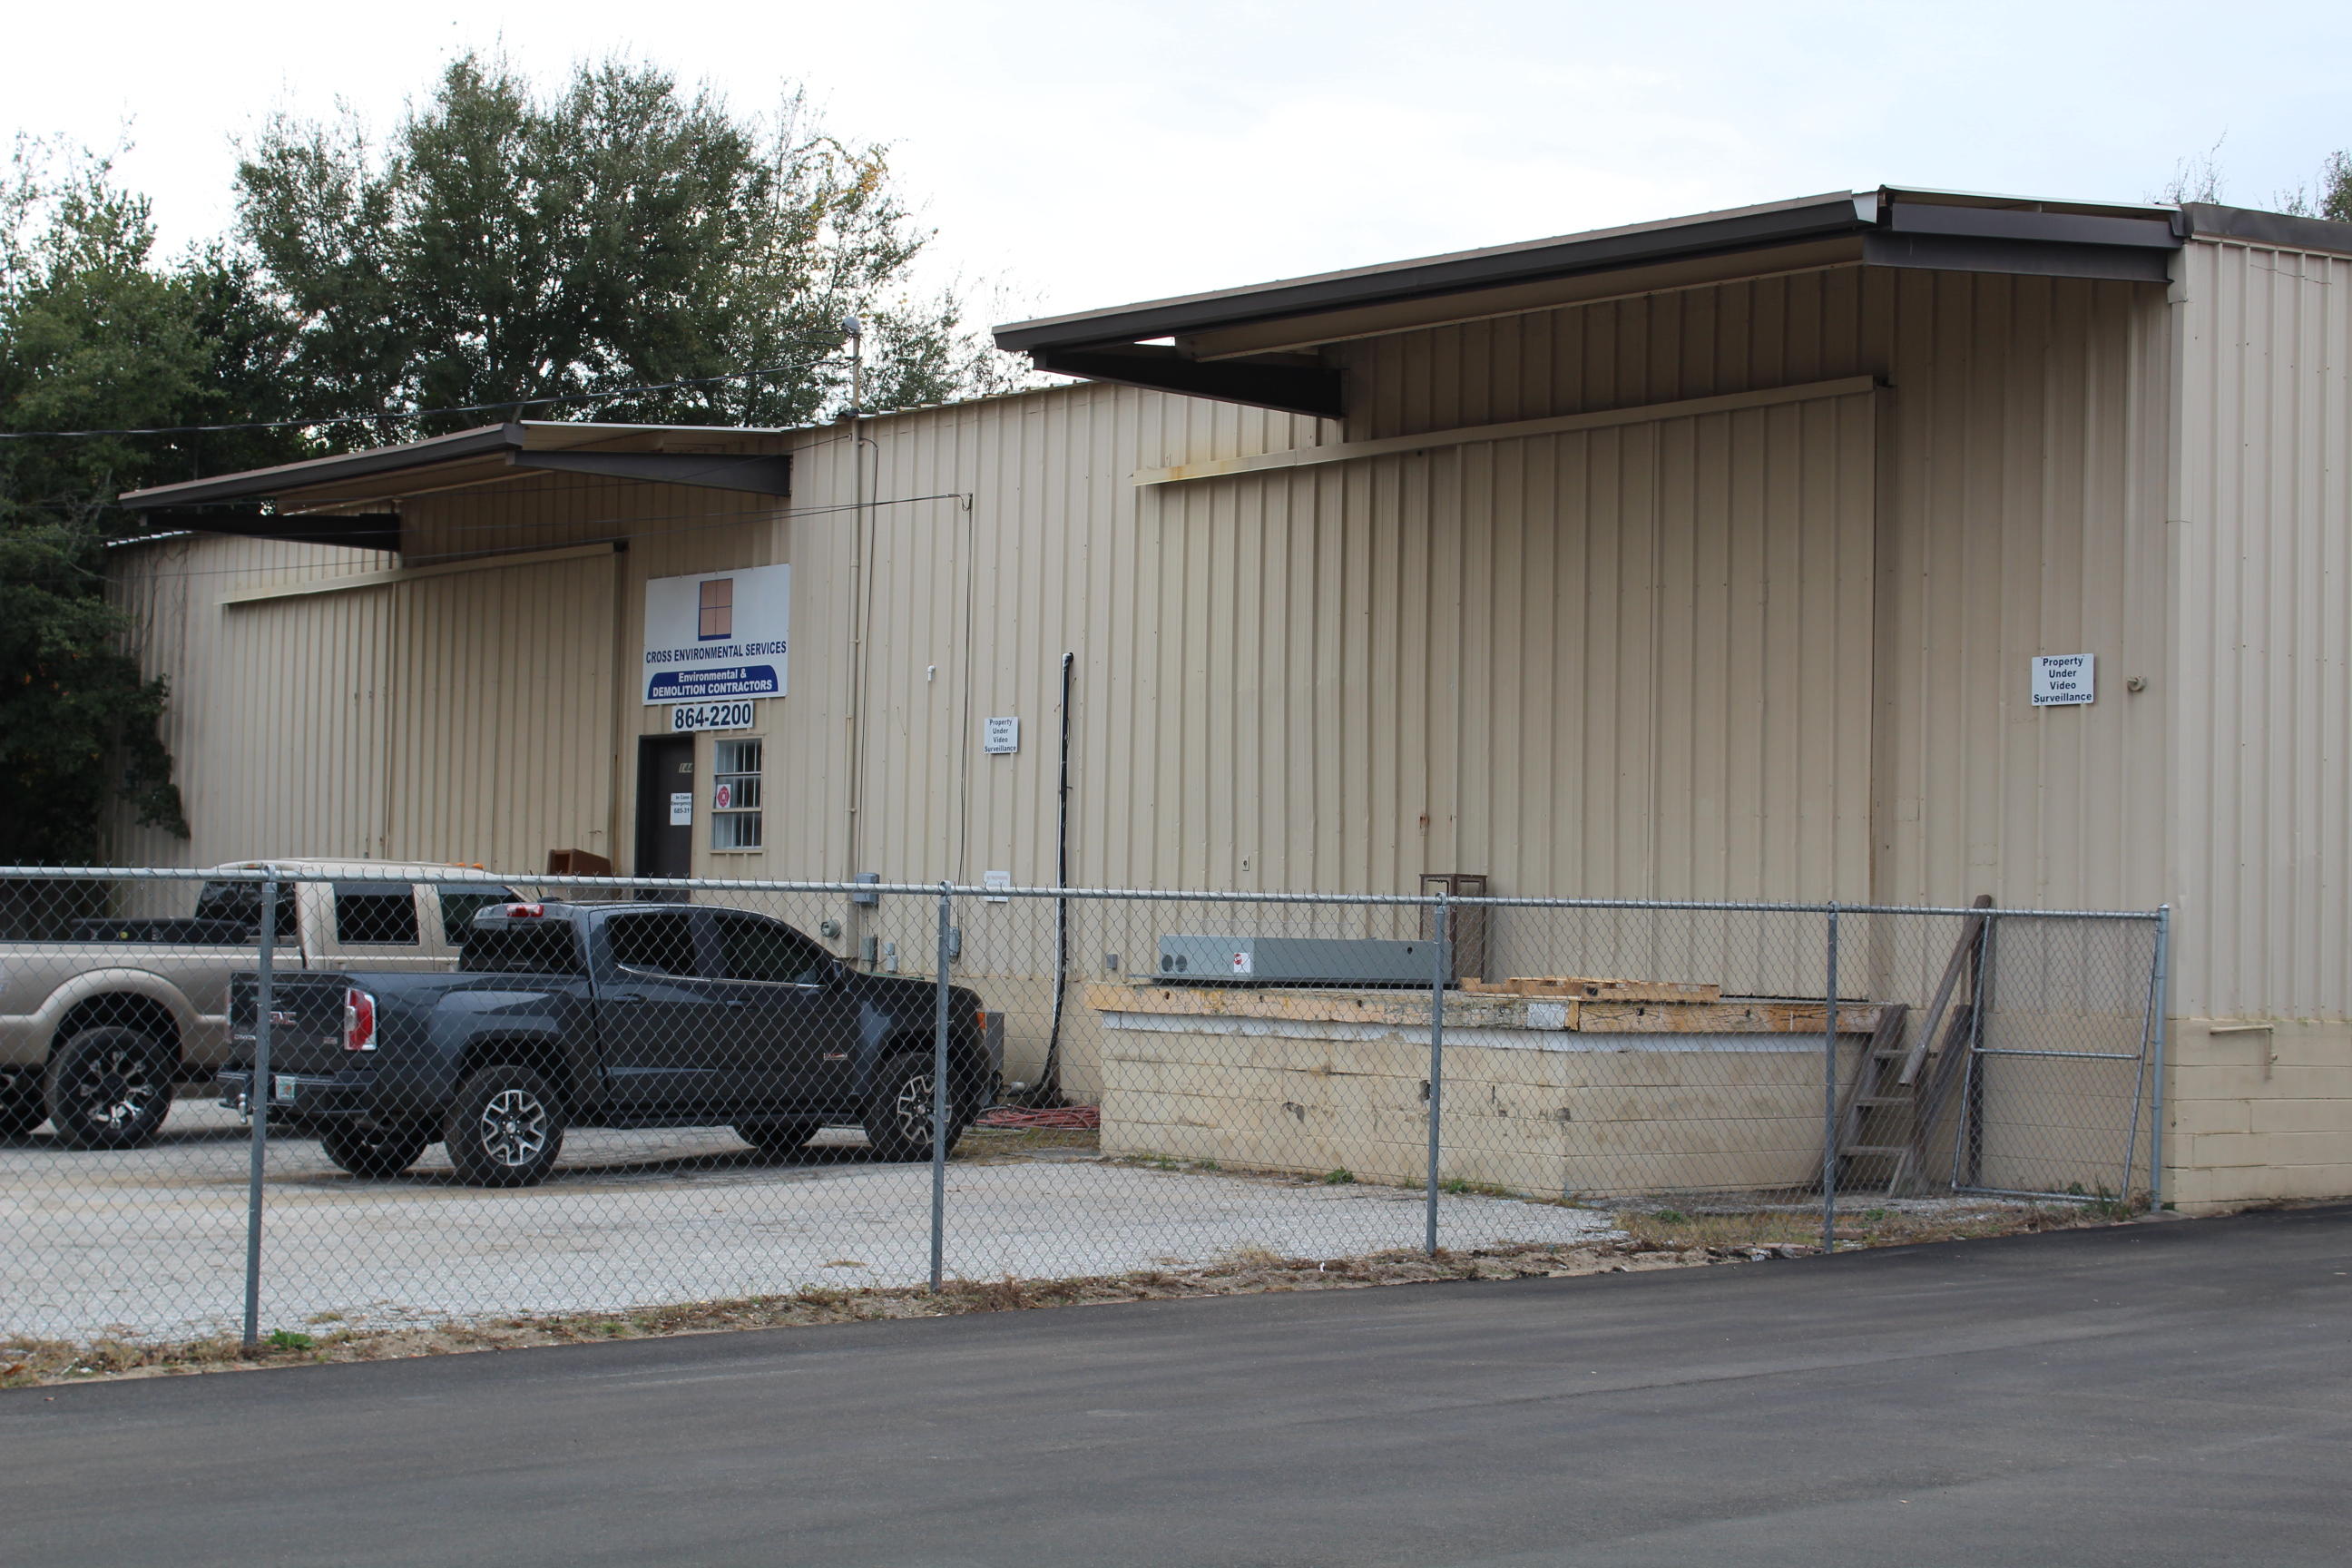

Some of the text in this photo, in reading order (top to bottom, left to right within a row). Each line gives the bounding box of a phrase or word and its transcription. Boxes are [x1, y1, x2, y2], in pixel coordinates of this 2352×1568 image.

[646, 641, 787, 663] CROSS ENVIRONMENTAL SERVICES
[2043, 657, 2083, 667] Property
[678, 668, 747, 682] Environmental &
[2048, 669, 2076, 678] Under
[652, 679, 772, 697] DEMOLITION CONTRACTORS
[2050, 681, 2076, 690] Video
[2034, 692, 2092, 702] Surveillance
[674, 703, 751, 729] 864-2200
